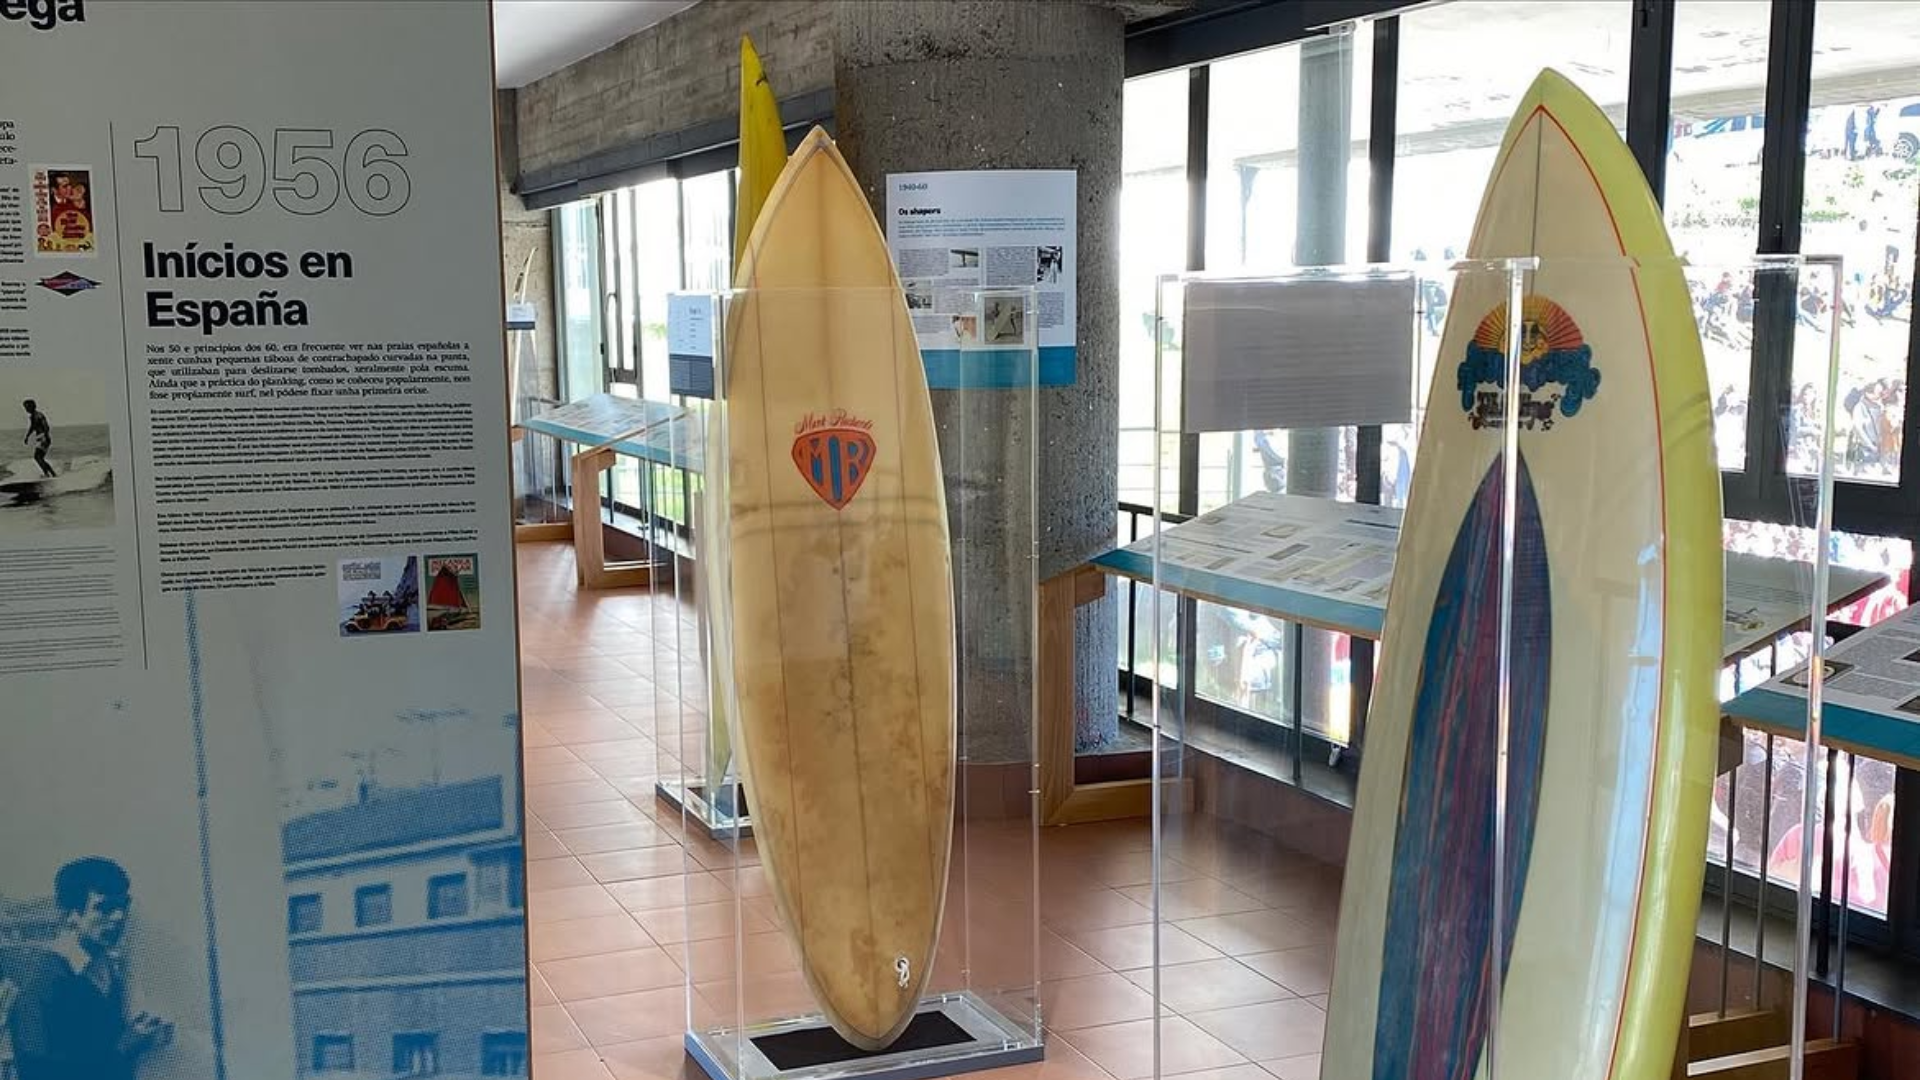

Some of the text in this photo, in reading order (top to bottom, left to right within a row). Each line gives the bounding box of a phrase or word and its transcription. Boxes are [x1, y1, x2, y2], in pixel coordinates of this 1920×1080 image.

[134, 125, 411, 216] 1956
[910, 207, 941, 216] shapers
[143, 242, 353, 278] Inícios en
[146, 290, 309, 335] España
[147, 344, 164, 353] Nos
[169, 344, 180, 352] 50
[245, 344, 261, 352] dos
[387, 342, 414, 352] praias
[417, 342, 460, 351] españolas
[177, 356, 212, 364] cunhas
[216, 356, 260, 366] pequenas
[312, 353, 379, 363] contrachapado
[148, 369, 166, 378] que
[171, 367, 220, 376] utilizaban
[225, 368, 246, 376] para
[251, 366, 298, 375] deslizarse
[410, 364, 429, 373] pola
[180, 380, 197, 389] que
[262, 377, 306, 387] planking,
[150, 390, 168, 399] fose
[172, 390, 232, 400] propiamente
[259, 389, 274, 397] nel
[312, 388, 333, 396] fixar
[363, 386, 401, 397] primeira
